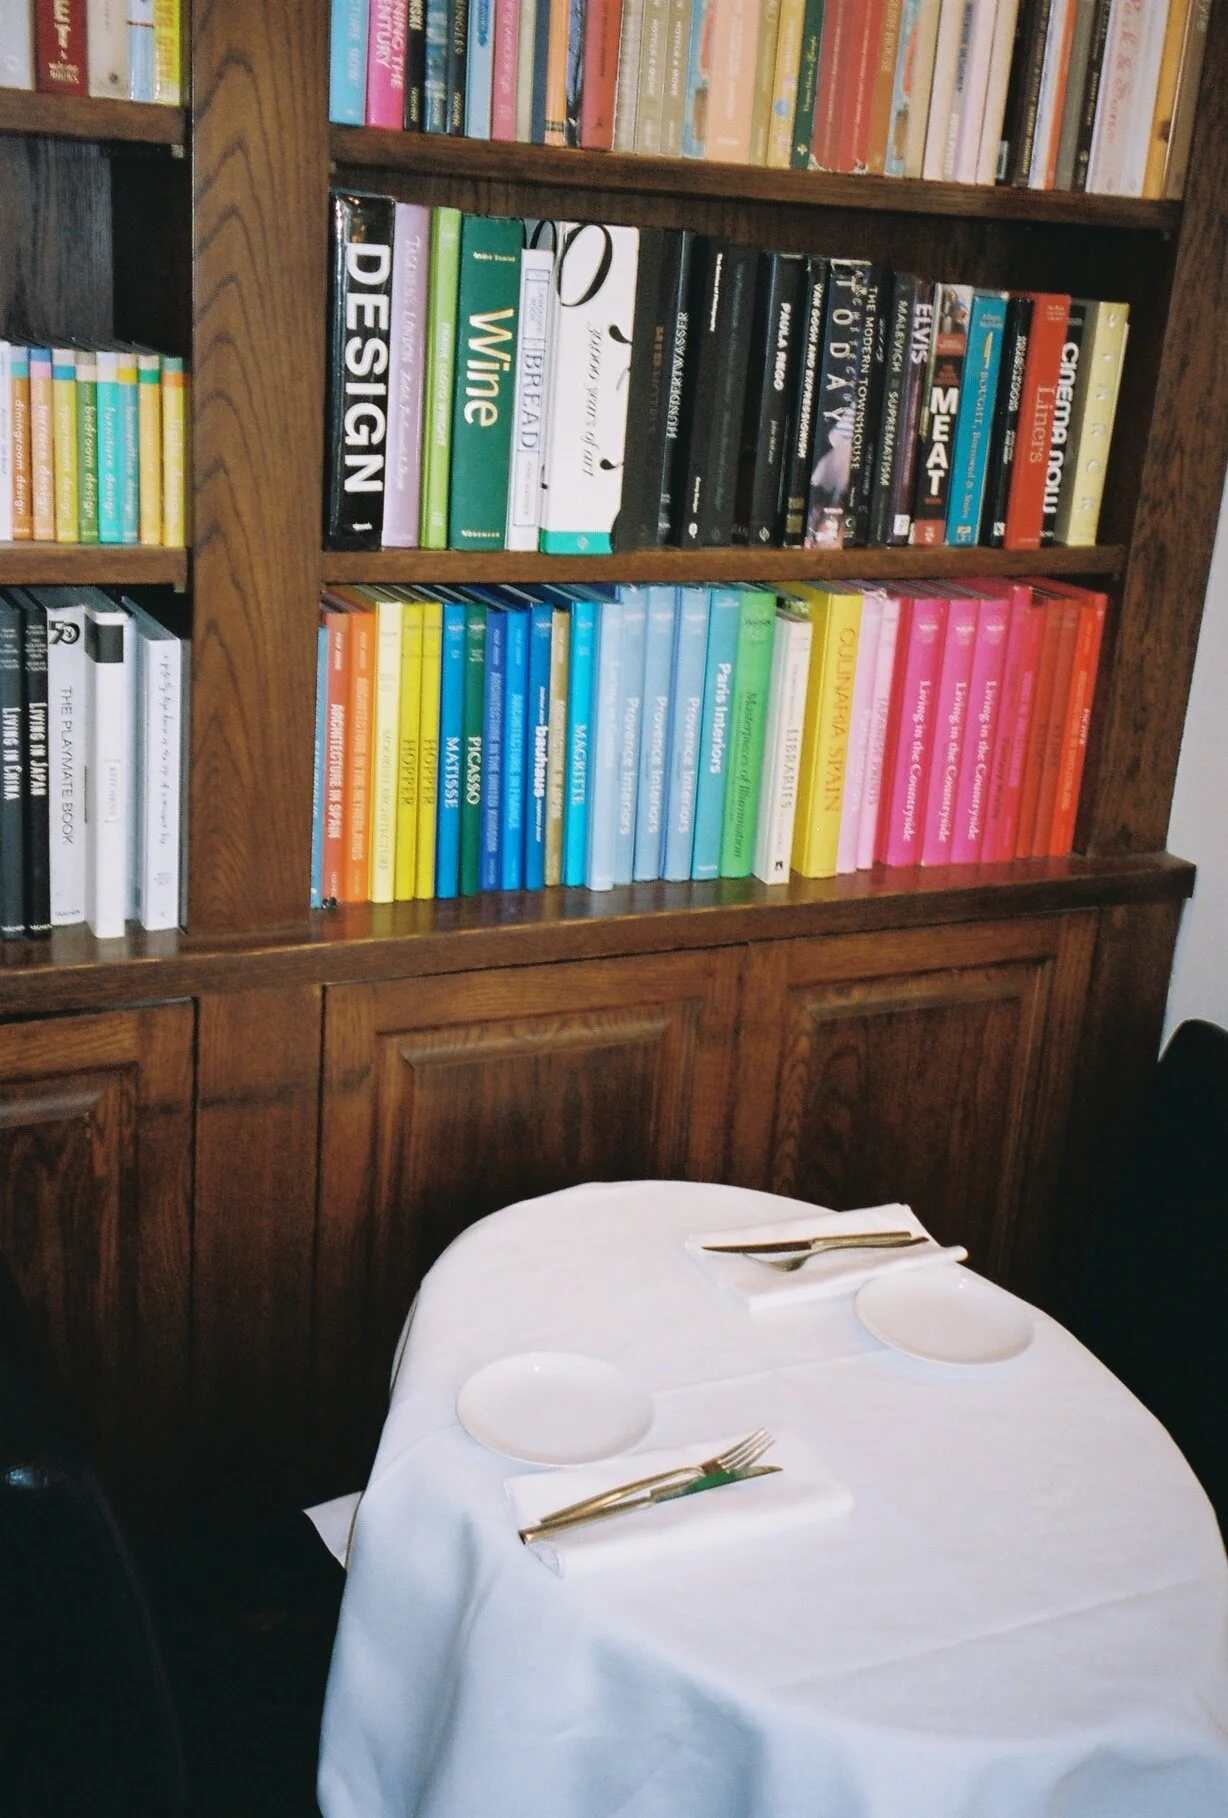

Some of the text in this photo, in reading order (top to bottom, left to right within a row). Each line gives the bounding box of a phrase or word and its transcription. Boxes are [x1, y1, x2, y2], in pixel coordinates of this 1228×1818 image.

[390, 53, 404, 89] THE
[672, 20, 683, 57] HOTELS
[865, 286, 878, 312] THE
[911, 303, 933, 365] ELVIS
[344, 242, 391, 493] DESIGN
[464, 308, 515, 427] Wine
[666, 311, 689, 439] HUNDERTWASSER
[772, 302, 792, 391] PAULA REGO
[796, 283, 824, 459] VAN GOGH AND EXPRESSIONISM
[822, 275, 858, 422] TODAY
[860, 316, 875, 374] MODERN
[520, 353, 543, 449] BREAD
[584, 379, 601, 427] years
[850, 377, 870, 471] TOWNHOUSE
[879, 300, 909, 487] MALEVICH SUPREMATISM
[1030, 385, 1056, 463] Liners
[1080, 311, 1121, 512] STARCK
[13, 399, 26, 515] diningroom design
[82, 405, 97, 520] bedroom design
[581, 430, 600, 450] of
[582, 449, 595, 478] art
[926, 386, 960, 496] MEAT
[35, 464, 51, 516] design
[104, 472, 117, 520] design
[328, 703, 345, 788] ARCHITECTURE
[353, 677, 370, 753] ARCHITECTURE
[488, 671, 502, 741] ARCHITECTURE
[710, 662, 732, 774] Paris Interiors
[824, 627, 857, 812] CULINARIA SPAIN
[1, 707, 23, 801] LIVING IN CHINA
[29, 702, 49, 796] LIVING IN JAPAN
[60, 686, 74, 845] THE PLAYMATE BOOK
[352, 769, 364, 789] THE
[353, 756, 364, 768] IN
[400, 739, 417, 805] HOPPER
[421, 739, 438, 805] HOPPER
[444, 736, 461, 809] MATISSE
[466, 736, 482, 805] PICASSO
[487, 773, 500, 807] UNITED
[488, 743, 501, 755] IN
[488, 755, 501, 772] THE
[507, 693, 524, 829] ARCHITECTURE IN FRANCE
[533, 725, 549, 798] bauhaus
[571, 723, 588, 806] MAGRITTE
[619, 696, 640, 836] Provence Interiors
[647, 695, 669, 834] Provence Interiors
[678, 696, 701, 834] Provence Interiors
[734, 691, 759, 859] Masterpieces of Illumination
[779, 728, 800, 809] LIBRARIES
[903, 680, 932, 842] Living in the Countryside
[938, 682, 968, 842] Living in the Countryside
[968, 680, 998, 841] Living in the Countryside
[327, 803, 341, 839] SPAIN
[328, 788, 341, 801] IN
[350, 790, 363, 861] NETHERLANDS
[486, 809, 499, 853] KINGDOM
